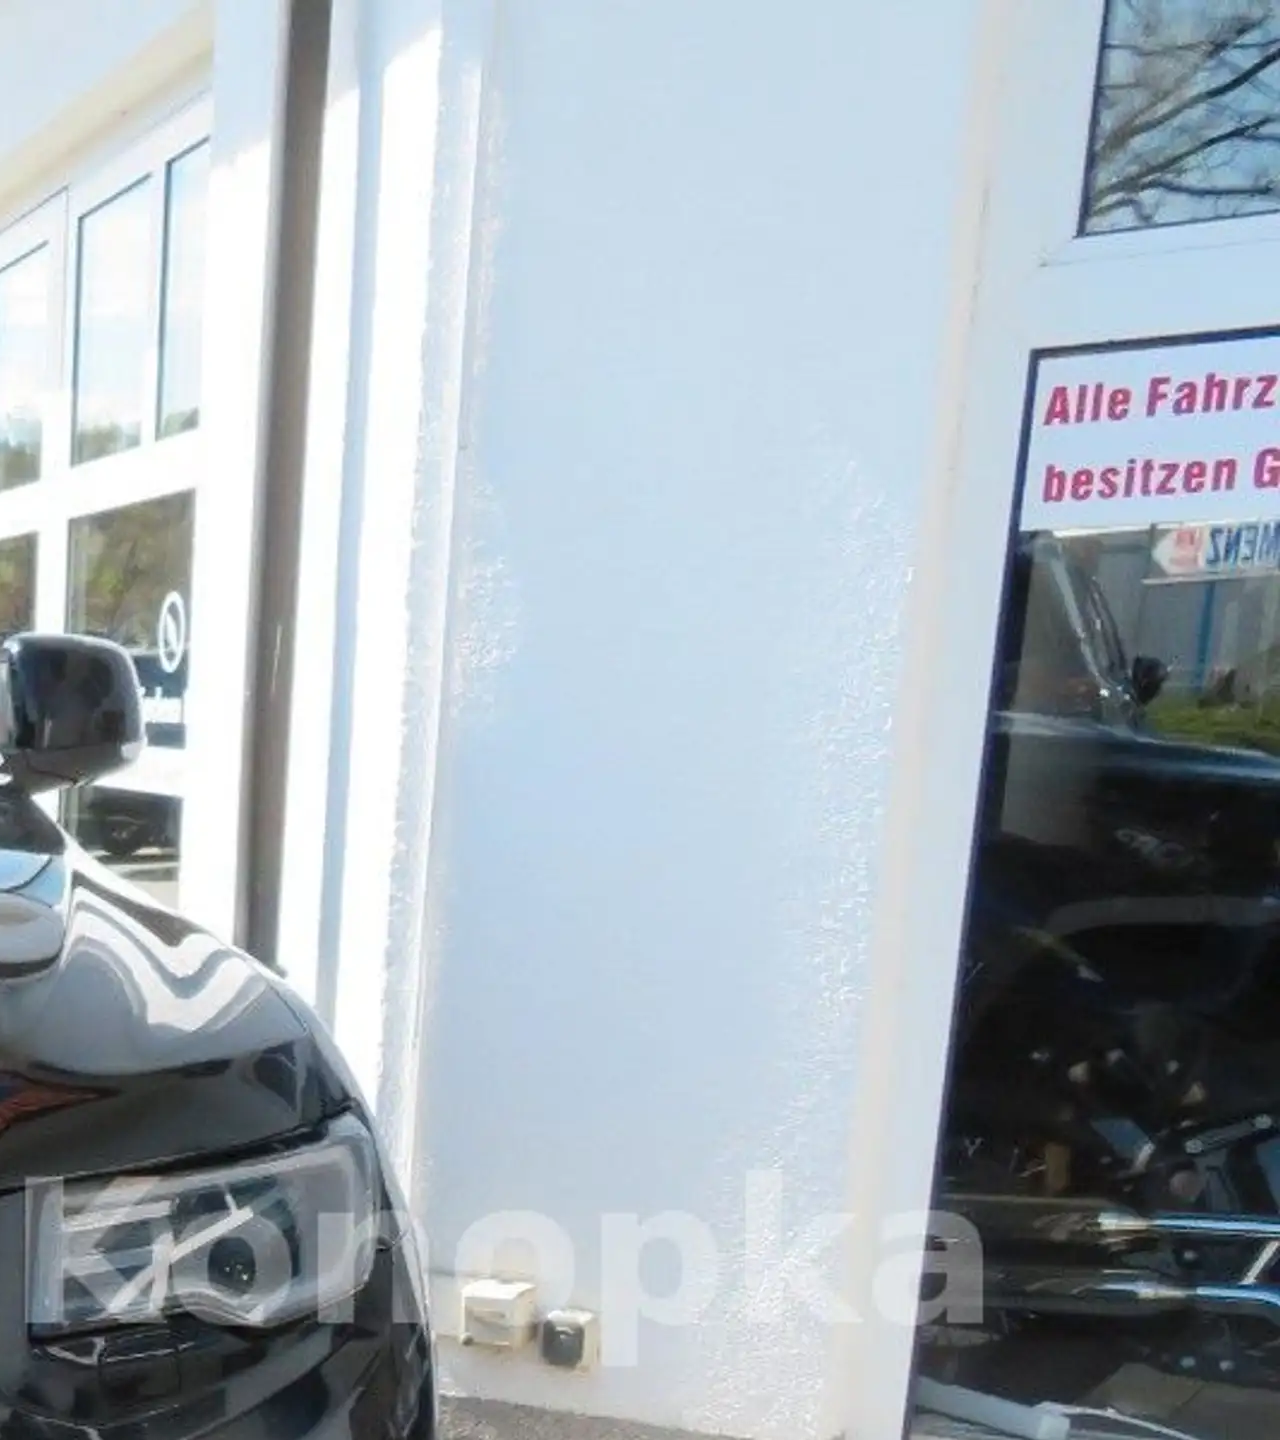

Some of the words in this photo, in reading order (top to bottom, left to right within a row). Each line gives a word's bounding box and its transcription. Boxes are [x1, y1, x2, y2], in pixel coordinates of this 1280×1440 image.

[1043, 384, 1131, 425] Alle
[1145, 372, 1279, 417] Fahrz
[1043, 459, 1236, 502] besitzen
[1253, 447, 1280, 489] G
